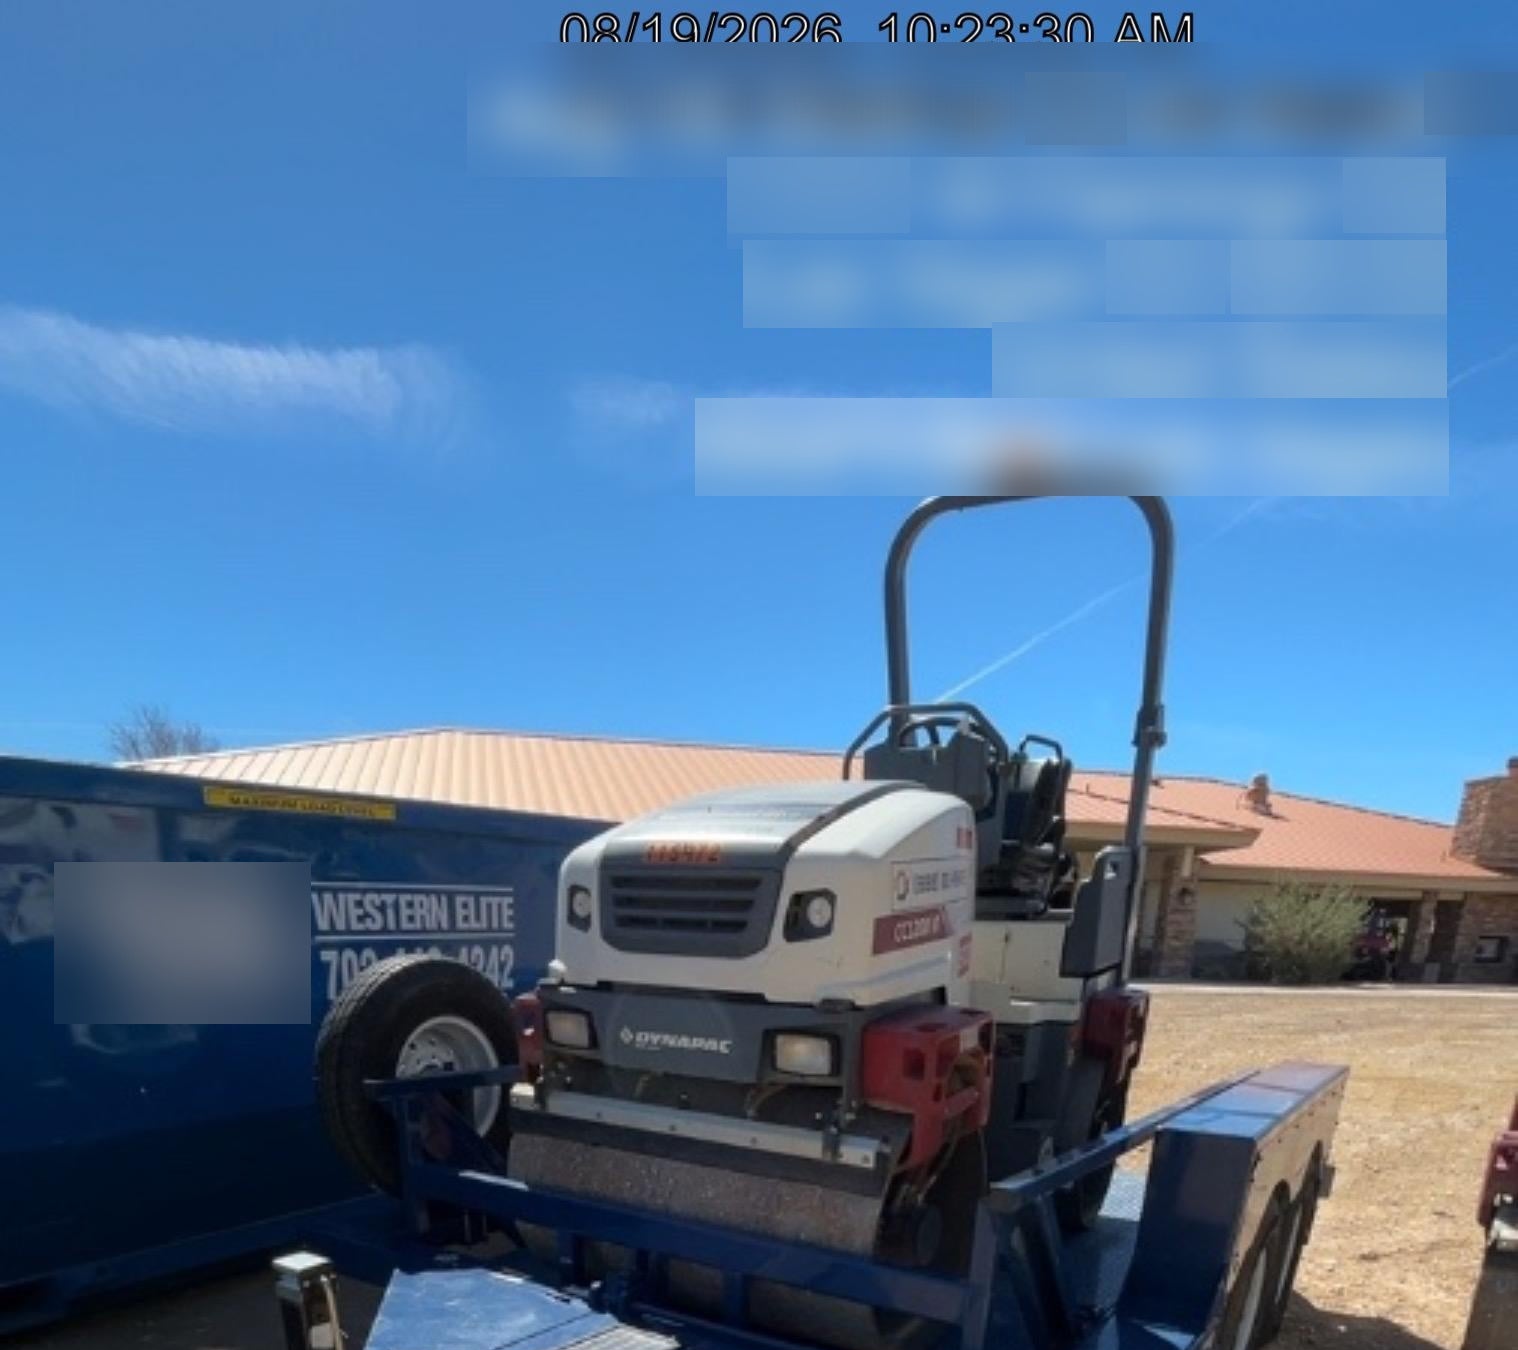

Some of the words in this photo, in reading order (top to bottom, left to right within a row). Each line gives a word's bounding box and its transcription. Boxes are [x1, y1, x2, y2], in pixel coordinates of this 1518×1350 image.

[312, 891, 448, 931] WESTERN
[455, 896, 514, 930] ELITE
[635, 1030, 733, 1055] DYNAPAC
